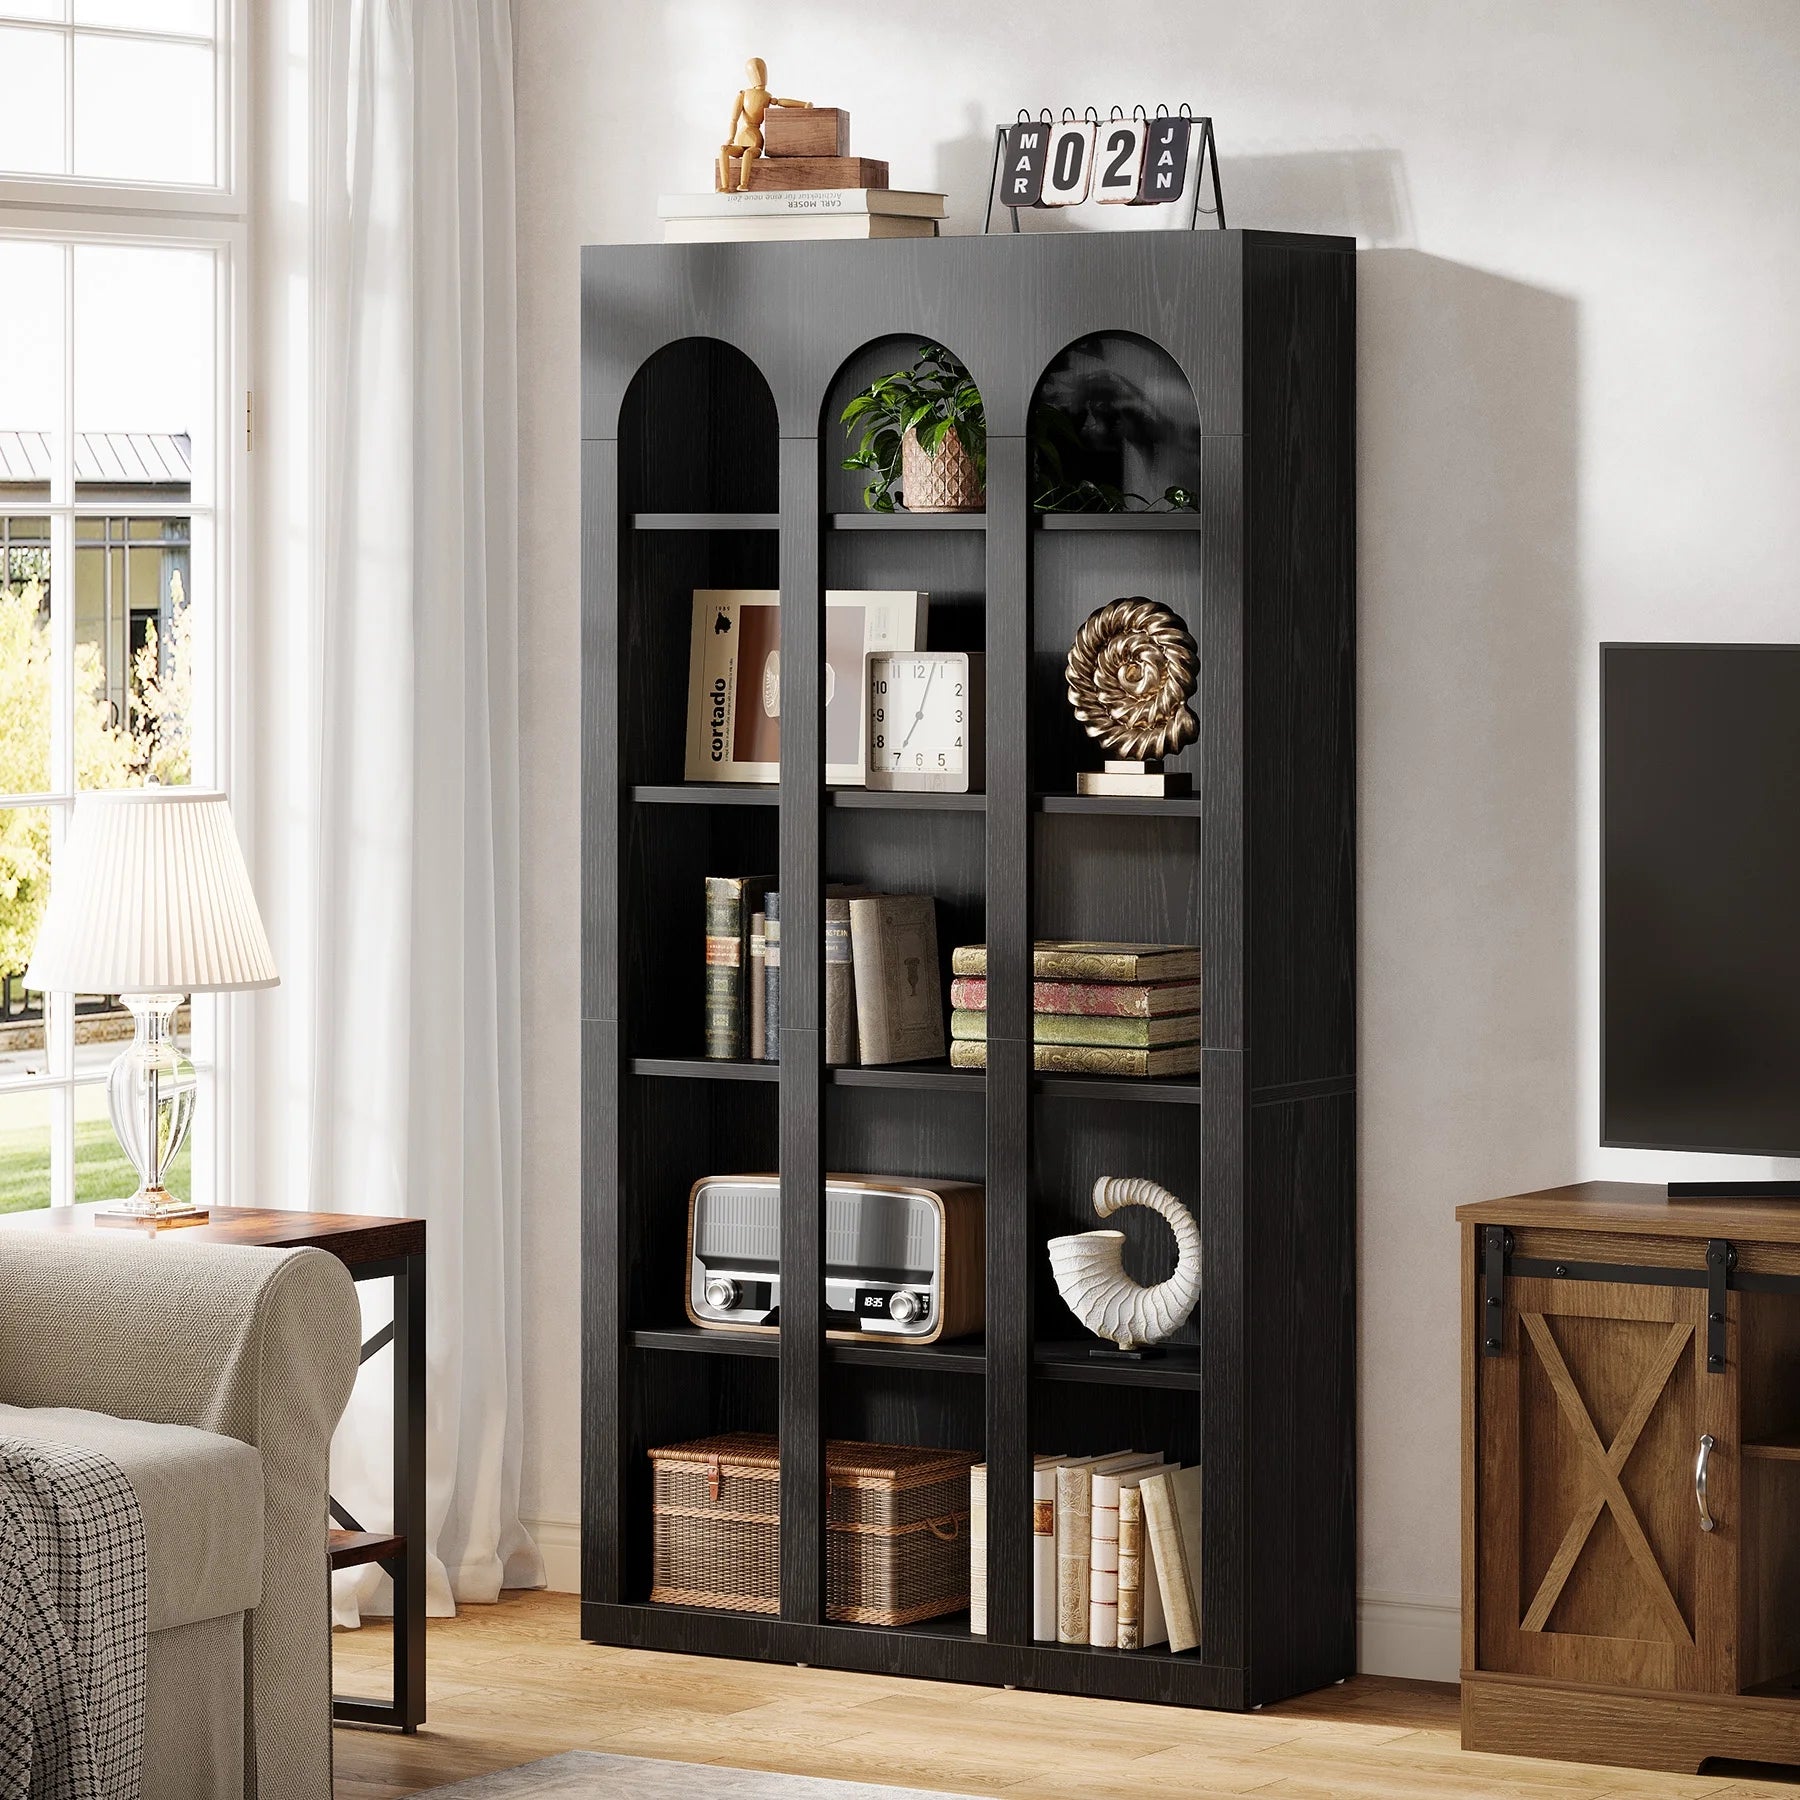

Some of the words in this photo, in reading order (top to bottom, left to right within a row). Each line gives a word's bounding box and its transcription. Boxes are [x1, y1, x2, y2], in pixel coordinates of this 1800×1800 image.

[1013, 132, 1039, 194] MAR
[1156, 127, 1174, 189] JAN
[788, 200, 817, 208] MOSER
[913, 664, 926, 679] 12
[876, 680, 887, 695] 10
[954, 683, 963, 697] 2
[709, 678, 726, 762] cortado
[876, 708, 885, 722] 9
[954, 709, 963, 723] 3
[876, 735, 885, 749] 8
[954, 736, 963, 747] 4
[893, 752, 902, 766] 7
[915, 753, 923, 767] 6
[937, 753, 946, 767] 5
[864, 1296, 883, 1308] 18:35
